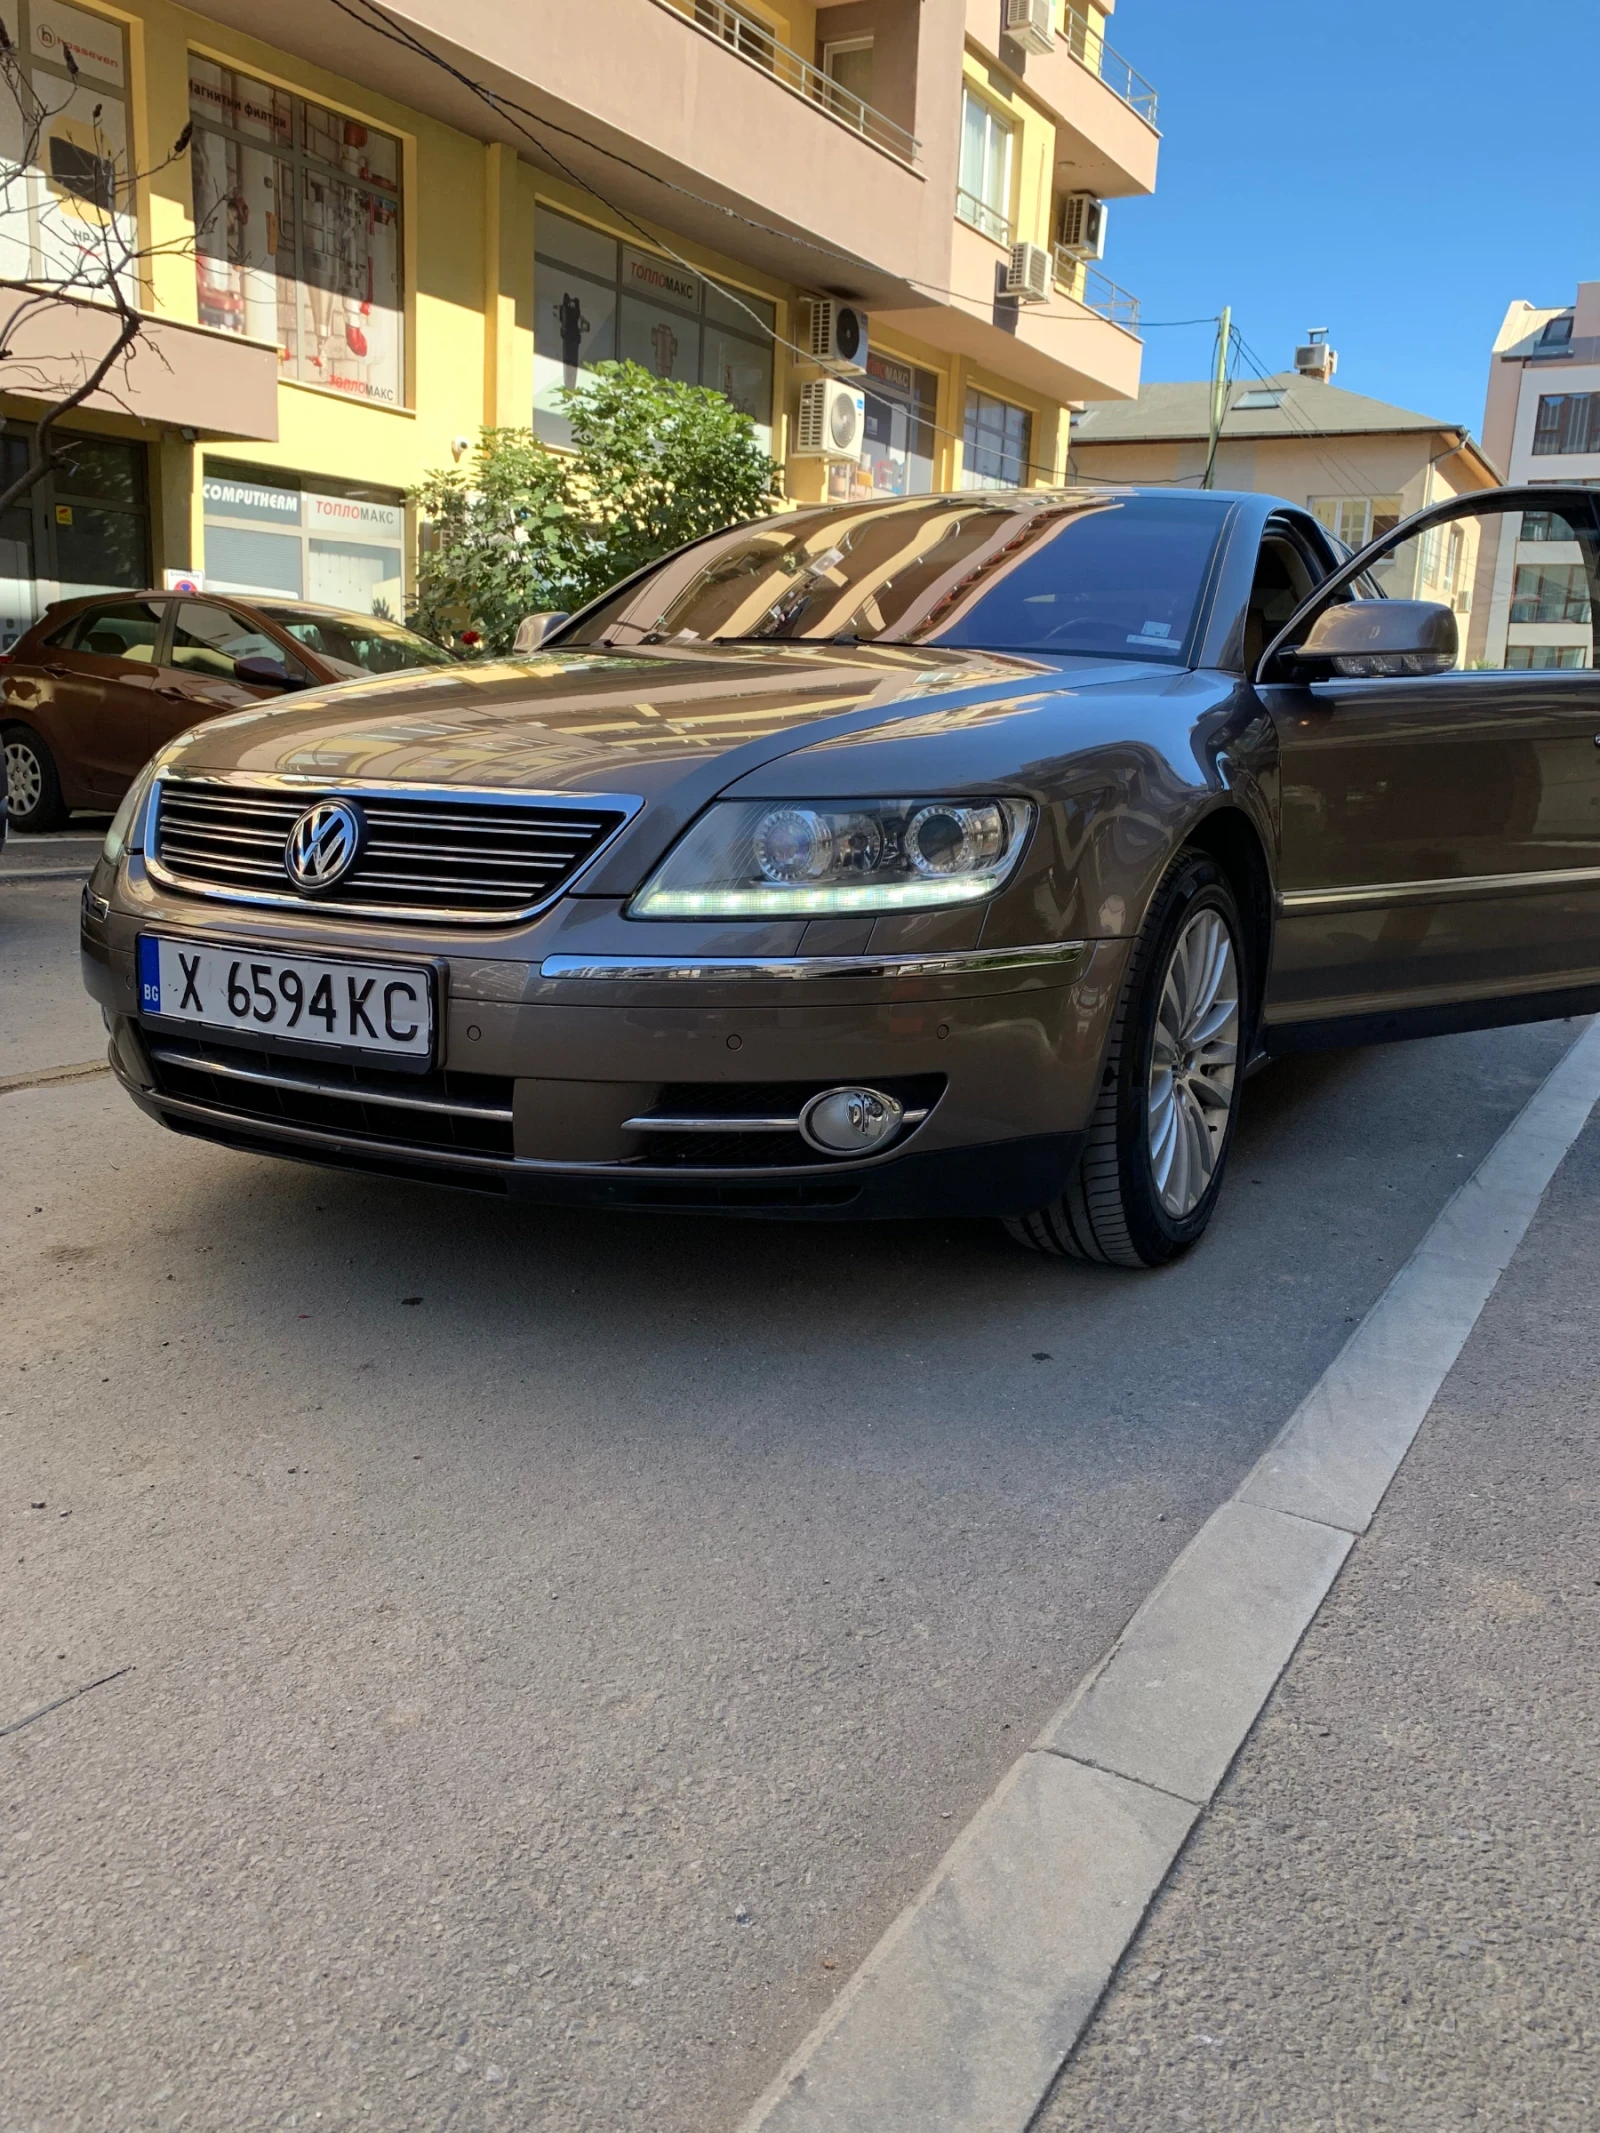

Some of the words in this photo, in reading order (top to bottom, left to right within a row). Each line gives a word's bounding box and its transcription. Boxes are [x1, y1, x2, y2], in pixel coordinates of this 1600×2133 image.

[244, 102, 286, 128] филтри
[630, 261, 693, 299] ТОПЛОМАКС
[329, 374, 394, 401] ТОПЛОМАКС
[202, 483, 298, 512] COMPUTHERM
[316, 500, 394, 525] ТОПЛОМАКС
[143, 983, 159, 1001] BG
[178, 952, 204, 1012] X
